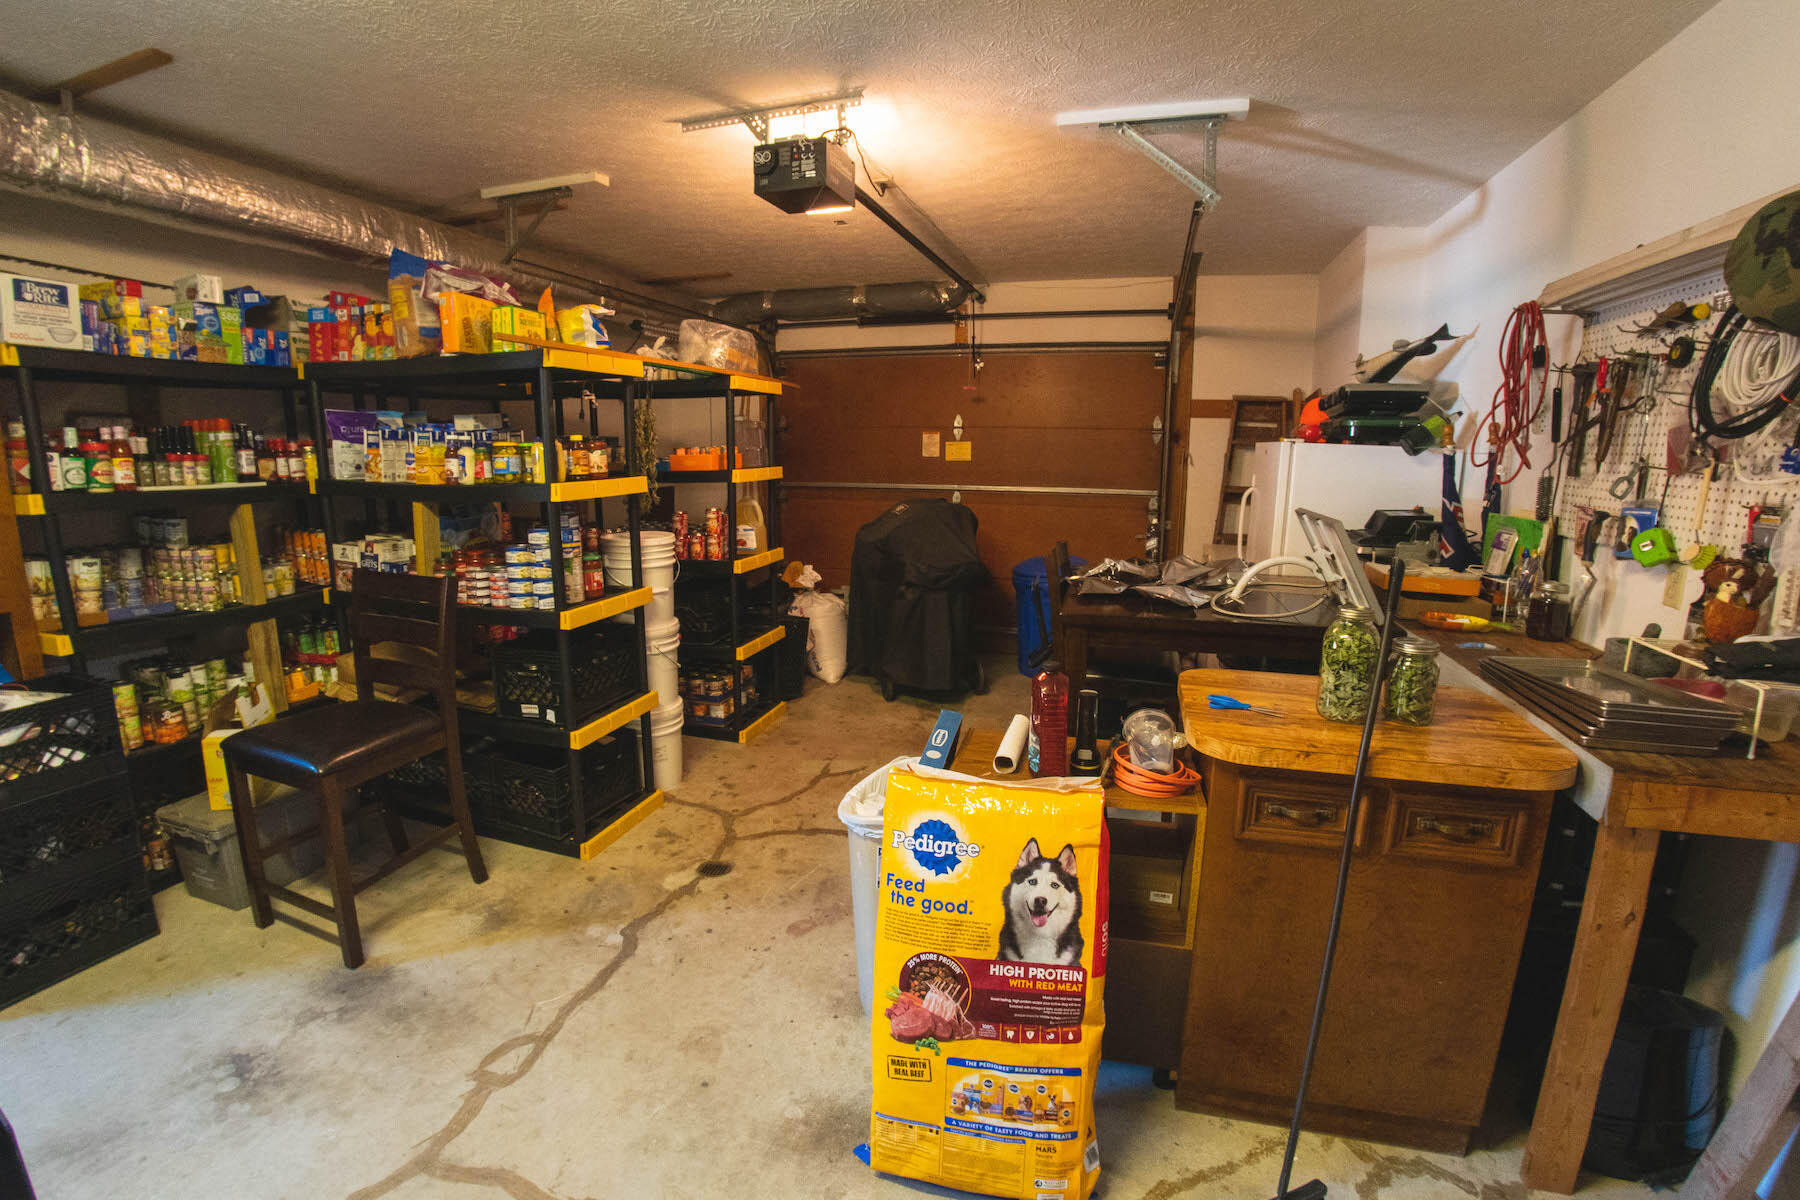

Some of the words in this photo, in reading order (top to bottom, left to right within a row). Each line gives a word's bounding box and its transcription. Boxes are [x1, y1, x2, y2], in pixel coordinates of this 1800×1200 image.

[26, 281, 60, 296] Brew
[891, 829, 980, 858] Pedigree
[886, 872, 925, 893] Feed
[890, 890, 916, 908] the
[921, 898, 973, 916] good.
[920, 953, 938, 961] MORE
[938, 954, 962, 974] PROTEIN
[989, 964, 1024, 978] HIGH
[1028, 967, 1083, 982] PROTEIN
[1008, 979, 1033, 989] WITH
[1036, 981, 1056, 990] RED
[1057, 982, 1083, 992] MEAT
[890, 1058, 908, 1069] MADE
[909, 1060, 927, 1070] WITH
[958, 1120, 983, 1130] VARIETY
[995, 1126, 1013, 1135] TASTY
[1015, 1129, 1033, 1138] FOOD
[1035, 1145, 1057, 1154] MARS
